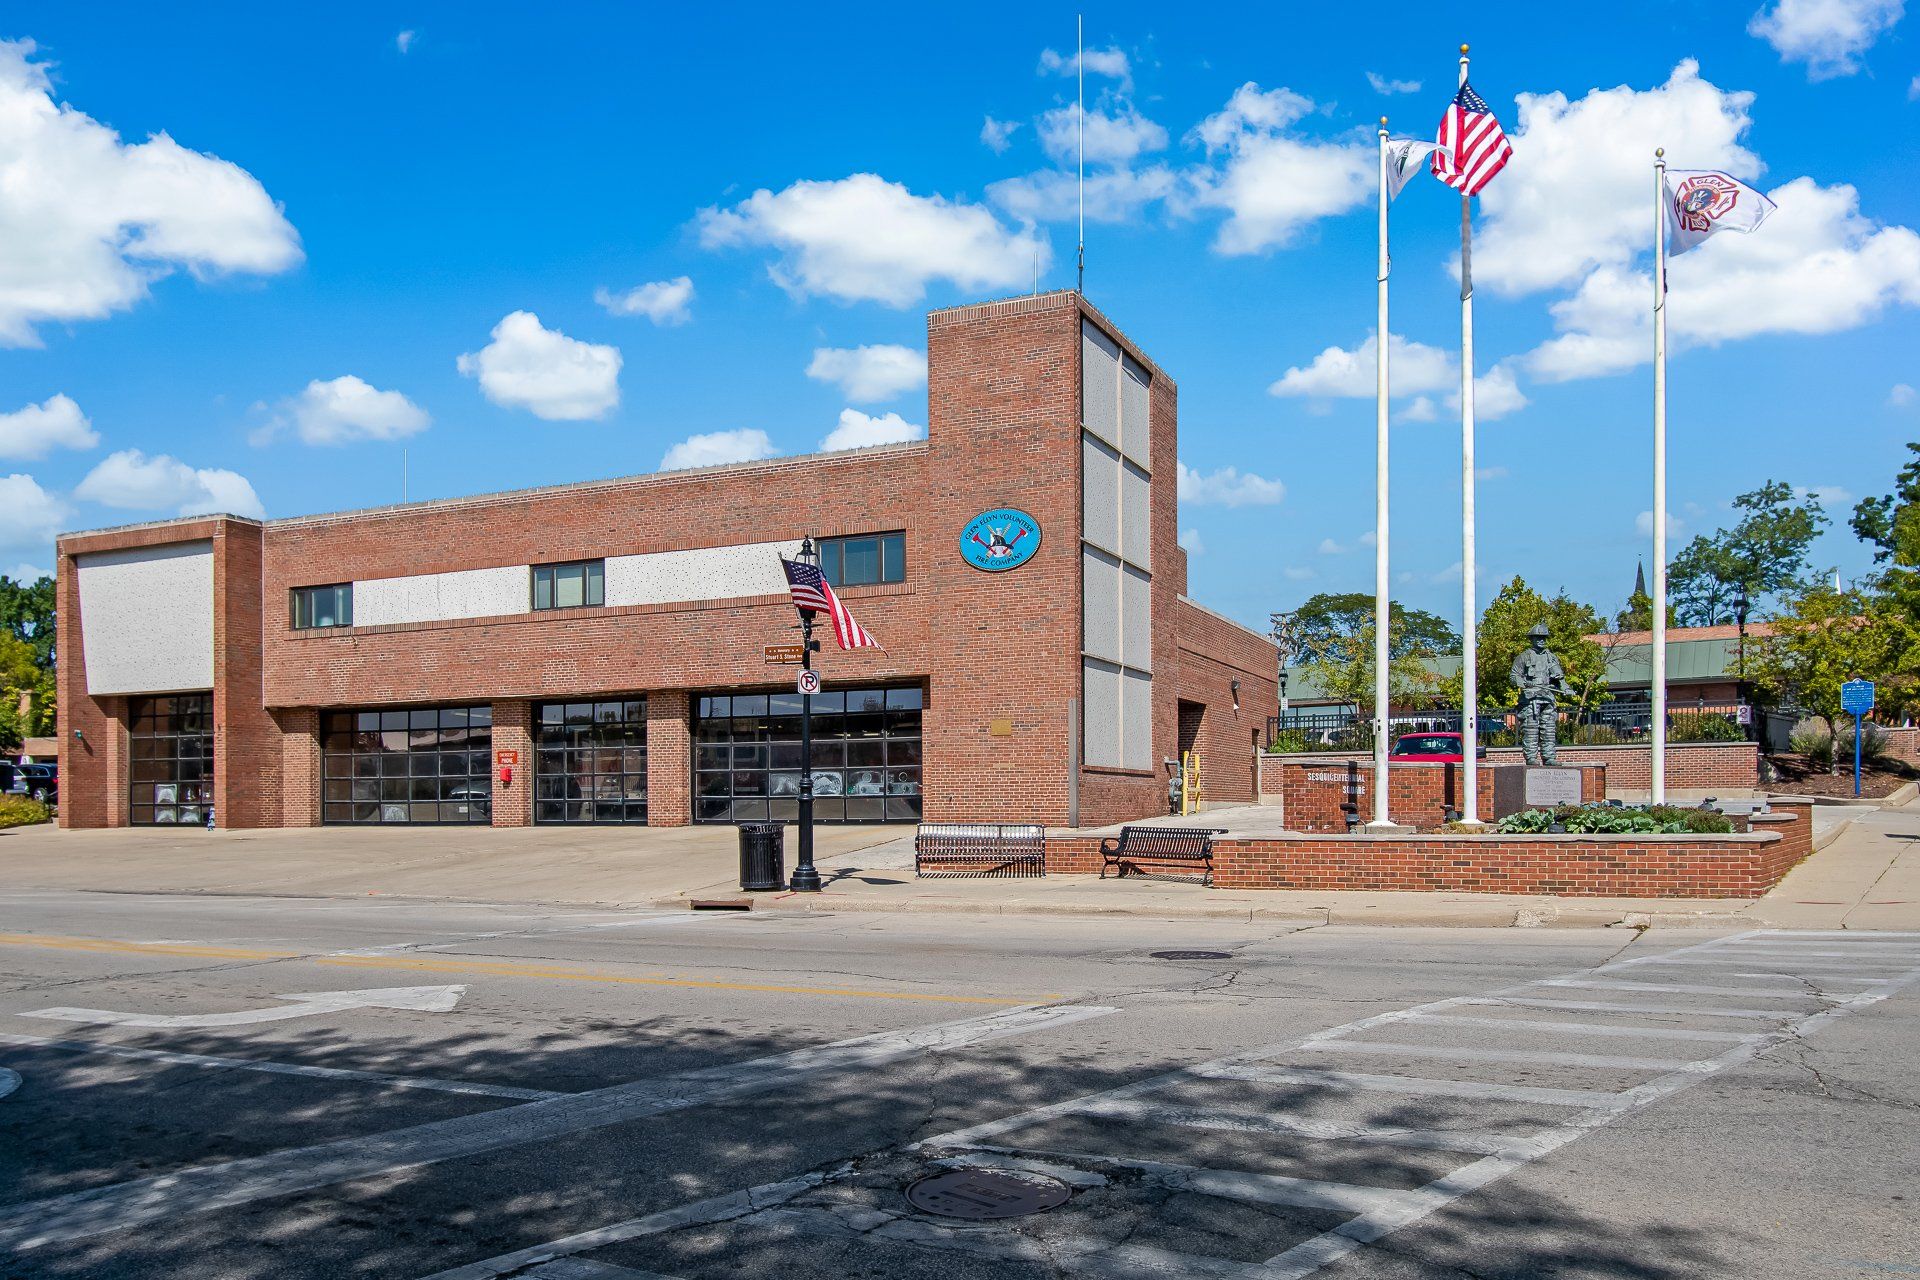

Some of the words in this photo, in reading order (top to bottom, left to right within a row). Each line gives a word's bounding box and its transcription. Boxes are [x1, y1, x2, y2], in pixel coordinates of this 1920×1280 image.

[1696, 178, 1723, 188] GLEN
[965, 524, 979, 540] GLEN
[979, 513, 998, 526] ELLYN
[999, 513, 1034, 534] VOLUNTEER
[975, 554, 988, 565] FIRE
[990, 552, 1023, 567] COMPANY
